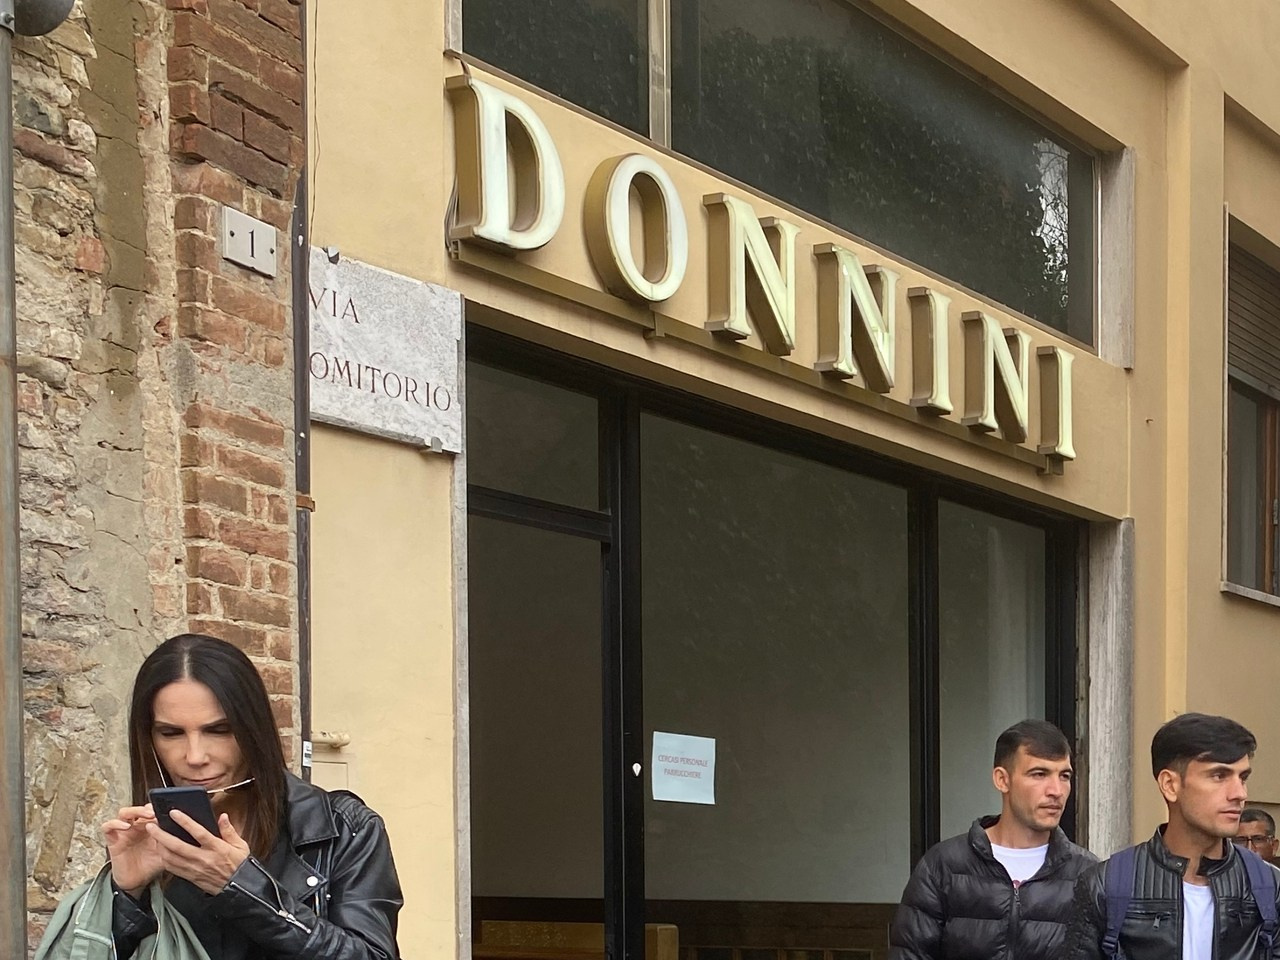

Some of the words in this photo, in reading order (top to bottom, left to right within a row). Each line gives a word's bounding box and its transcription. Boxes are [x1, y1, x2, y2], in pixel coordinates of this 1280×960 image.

[248, 229, 256, 259] 1
[447, 74, 1077, 461] DONNINI
[308, 287, 361, 324] VIA
